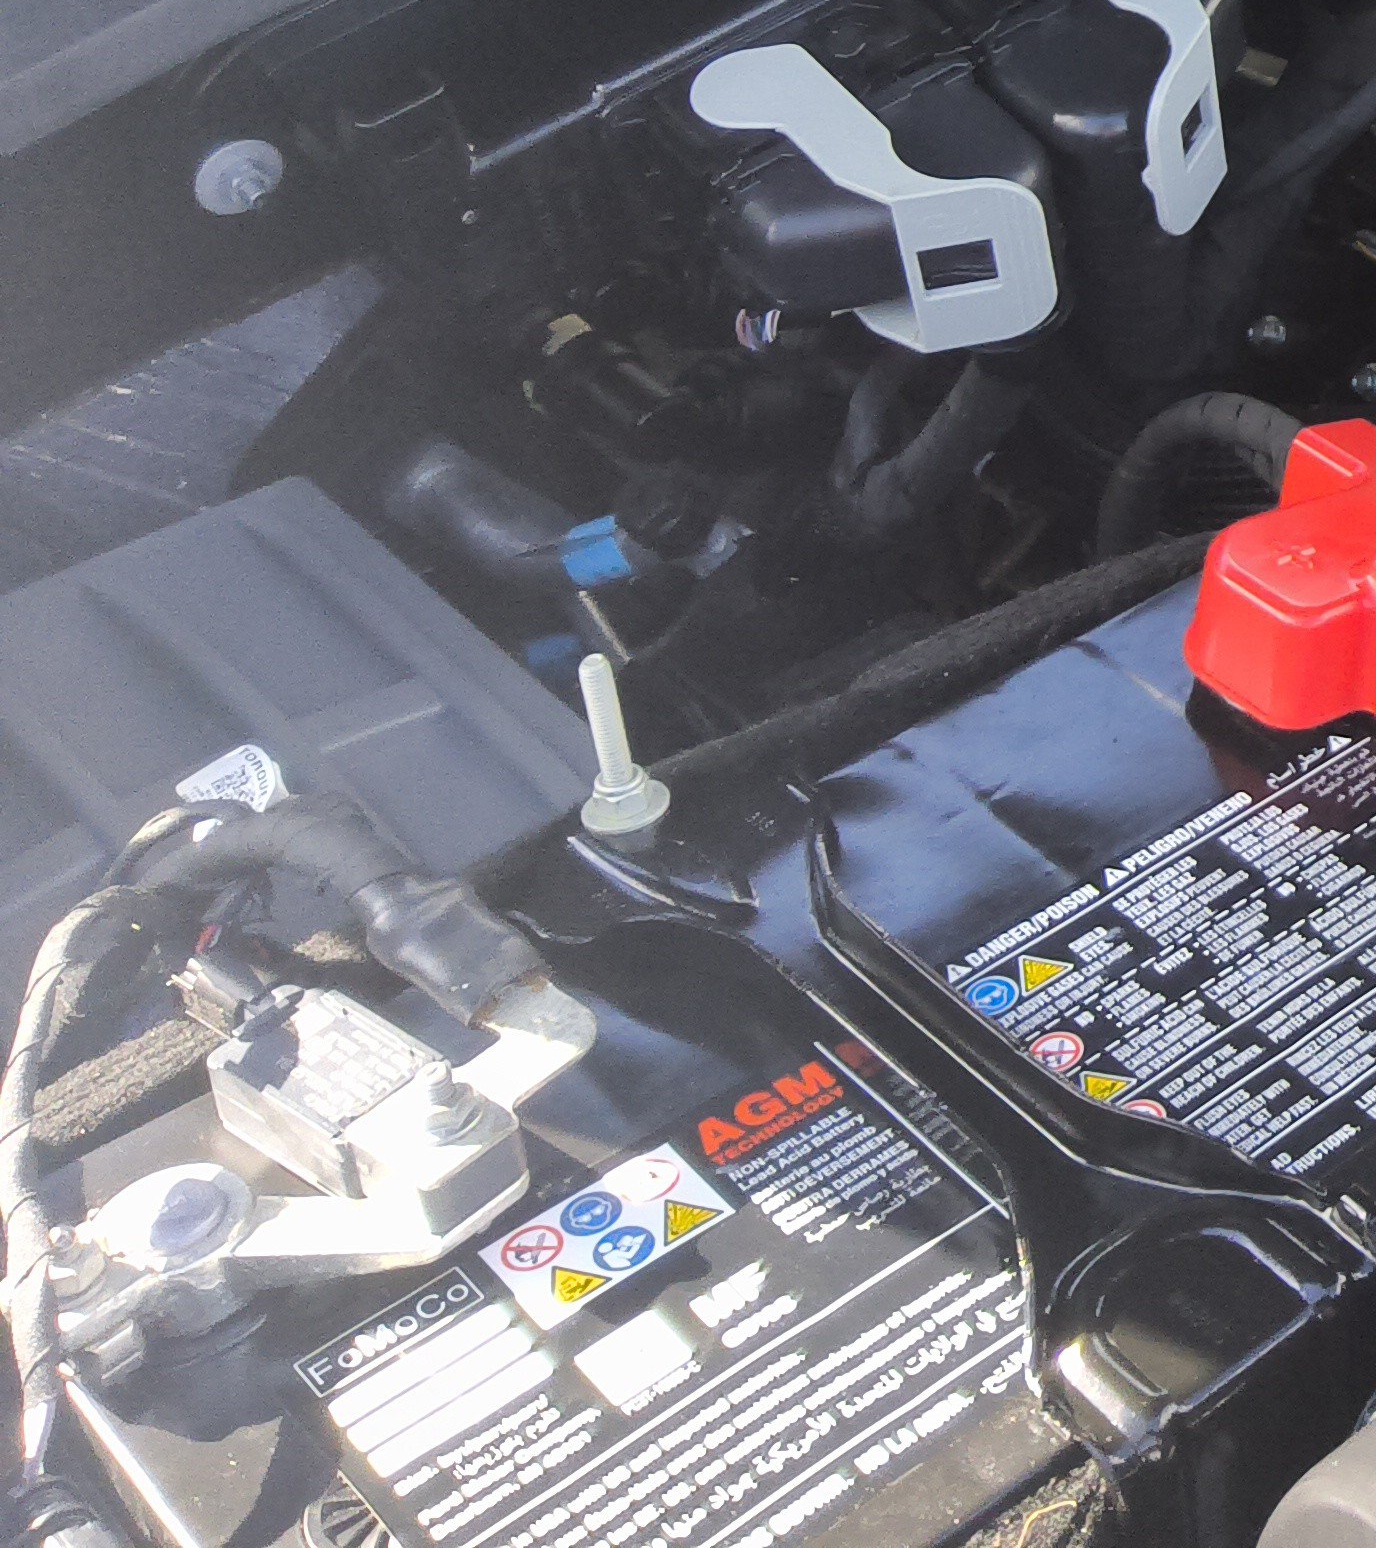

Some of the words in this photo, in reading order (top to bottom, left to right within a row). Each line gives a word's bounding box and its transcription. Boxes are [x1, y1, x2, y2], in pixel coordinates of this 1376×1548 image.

[1121, 792, 1252, 873] PELIGRO/VENENO
[1112, 897, 1131, 911] SE
[1174, 856, 1197, 872] LES
[1134, 892, 1189, 928] EXPLOSIFS
[965, 884, 1099, 967] DANGER/POISON
[1068, 927, 1110, 953] SHIELD
[998, 991, 1052, 1028] XPLOSIVE
[1047, 972, 1084, 996] GASES
[698, 1062, 836, 1155] AGM
[1159, 1078, 1189, 1098] KEEP
[712, 1086, 843, 1167] TECHNOLOGY
[728, 1107, 852, 1182] NON-SPILLABLE
[738, 1165, 777, 1191] Lead
[779, 1144, 812, 1170] Acid
[811, 1114, 864, 1147] Battery
[809, 1154, 830, 1167] au
[830, 1127, 882, 1158] plomb
[1224, 1123, 1255, 1146] ATER.
[1234, 1128, 1272, 1153] EDICAL
[831, 1141, 909, 1190] DERRAMES
[307, 1284, 480, 1385] FoMoCo
